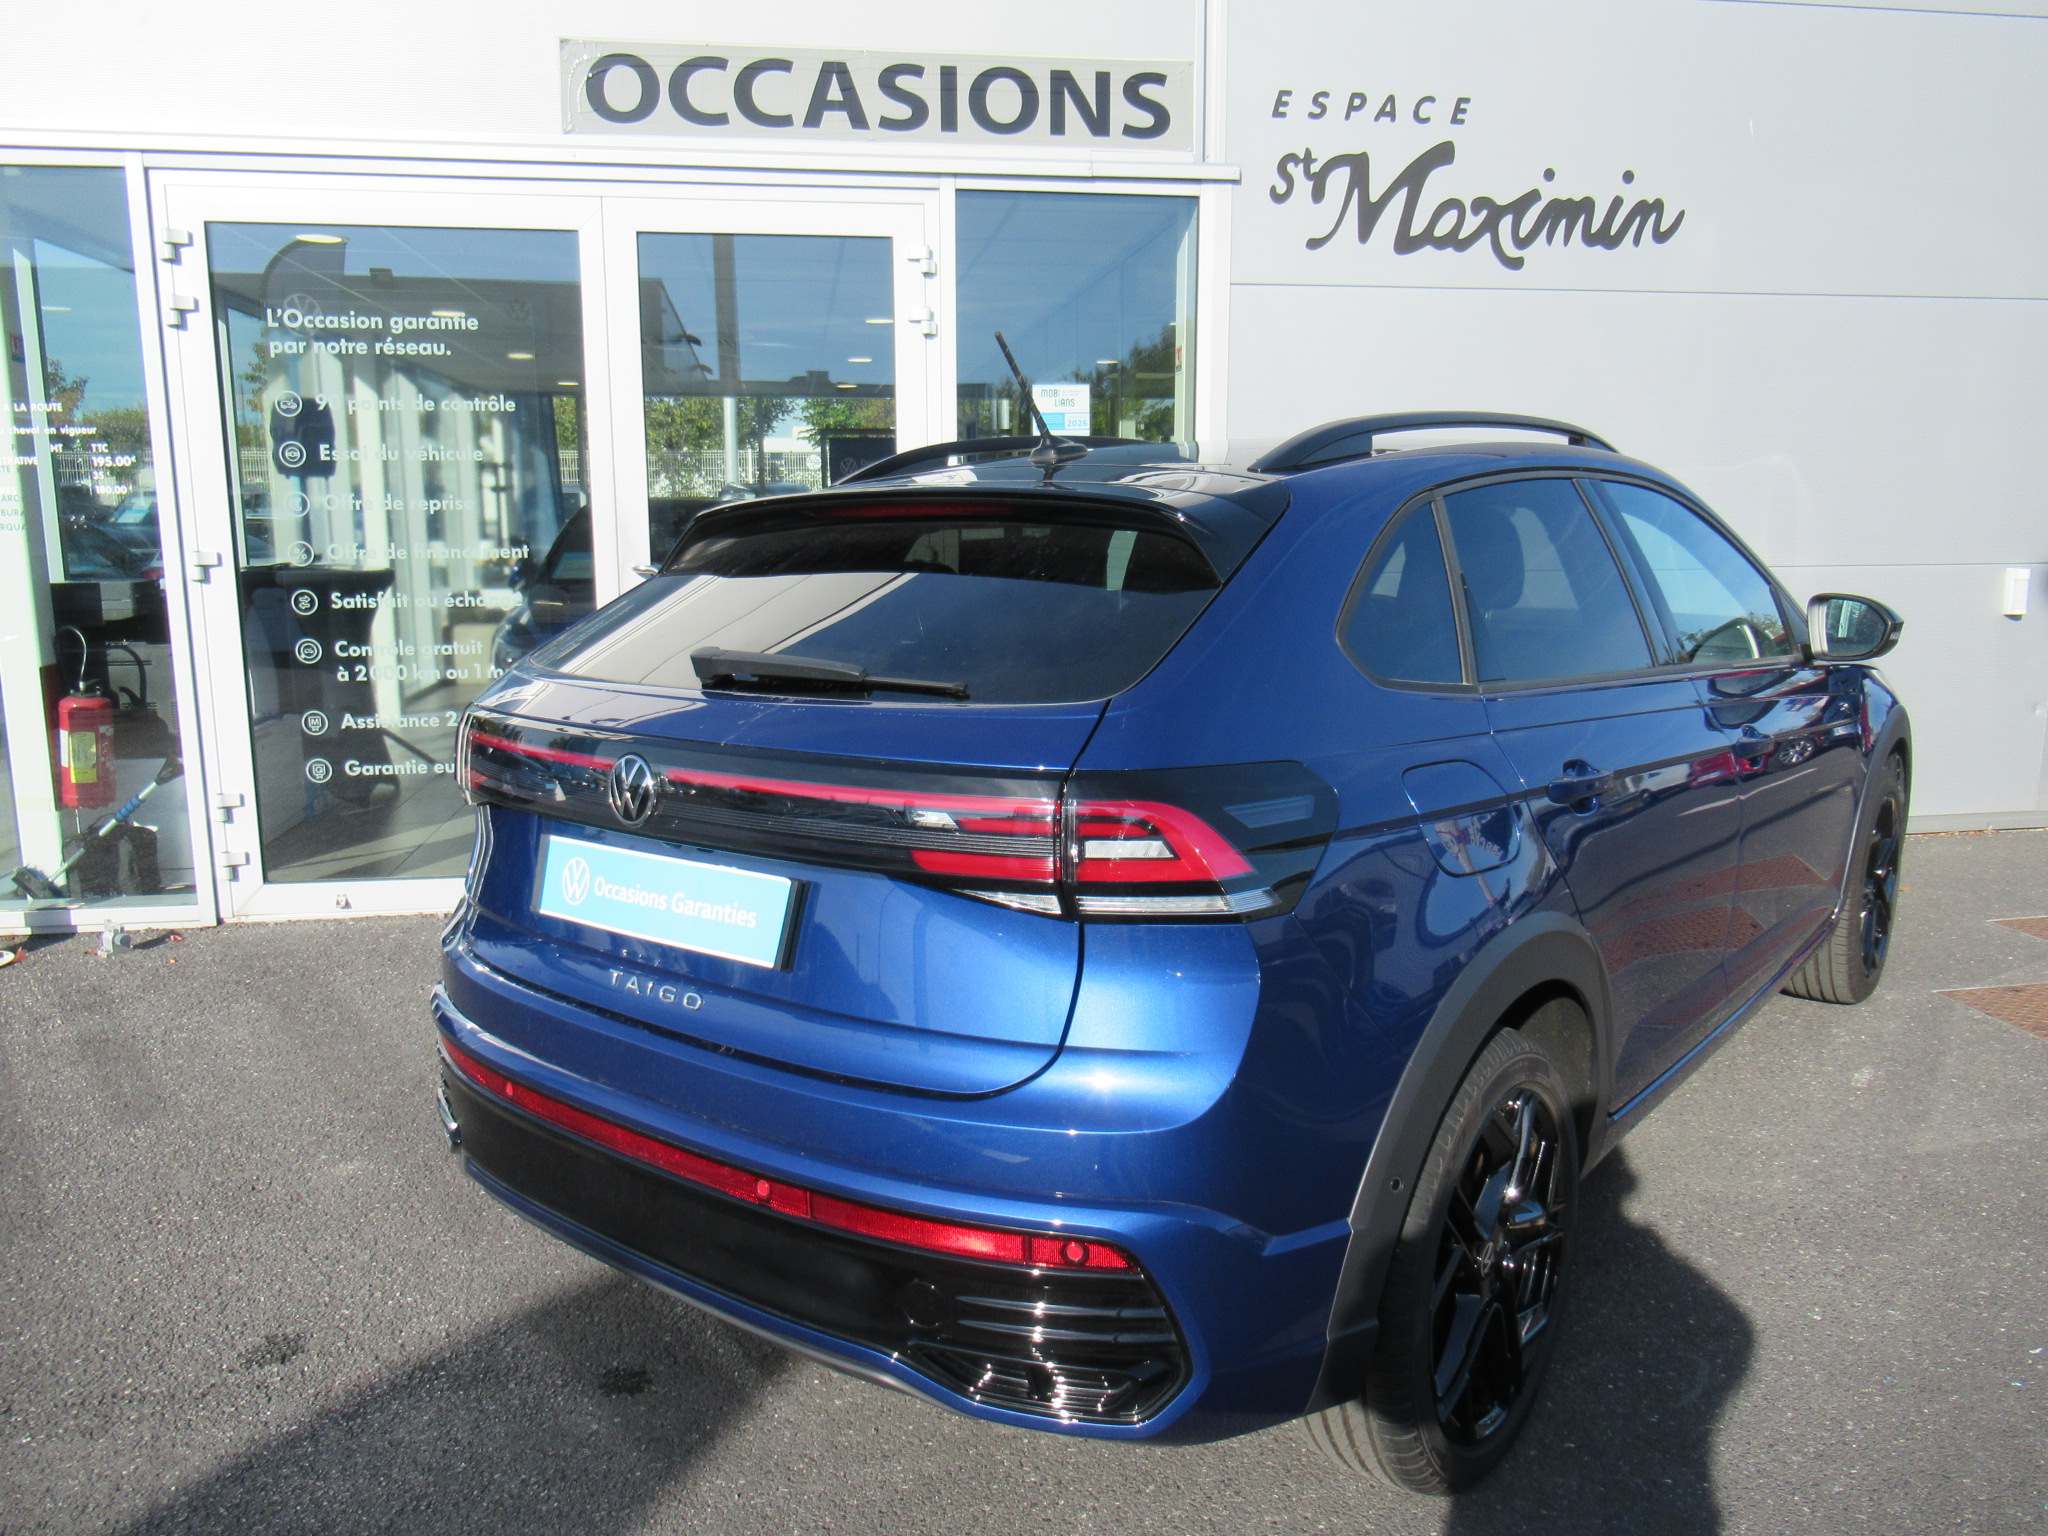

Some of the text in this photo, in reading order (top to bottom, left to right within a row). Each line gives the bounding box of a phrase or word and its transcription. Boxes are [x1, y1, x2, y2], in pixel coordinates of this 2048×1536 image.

[585, 52, 1172, 140] OCCASIONS
[1271, 90, 1472, 125] ESPACE
[1269, 140, 1685, 271] St Maximin
[266, 309, 479, 334] L'Occasion garantie
[270, 337, 452, 357] par notre réseau.
[14, 403, 27, 412] LA
[30, 402, 63, 412] ROUTE
[348, 398, 403, 415] ponts
[412, 394, 435, 412] de
[441, 394, 516, 412] contrôle
[9, 425, 39, 435] cheval
[44, 427, 57, 435] en
[59, 424, 97, 437] vigueur
[50, 443, 109, 453] HT TTC
[408, 443, 484, 461] véhicule
[383, 493, 404, 511] de
[388, 542, 408, 560] de
[422, 640, 484, 660] gratuit
[336, 664, 350, 682] à
[412, 664, 441, 680] km
[446, 667, 468, 680] ou
[473, 663, 482, 679] 1
[344, 759, 430, 776] Garantie
[594, 876, 668, 911] Occasions
[671, 892, 757, 928] Garanties
[609, 968, 705, 1011] TAIGO
